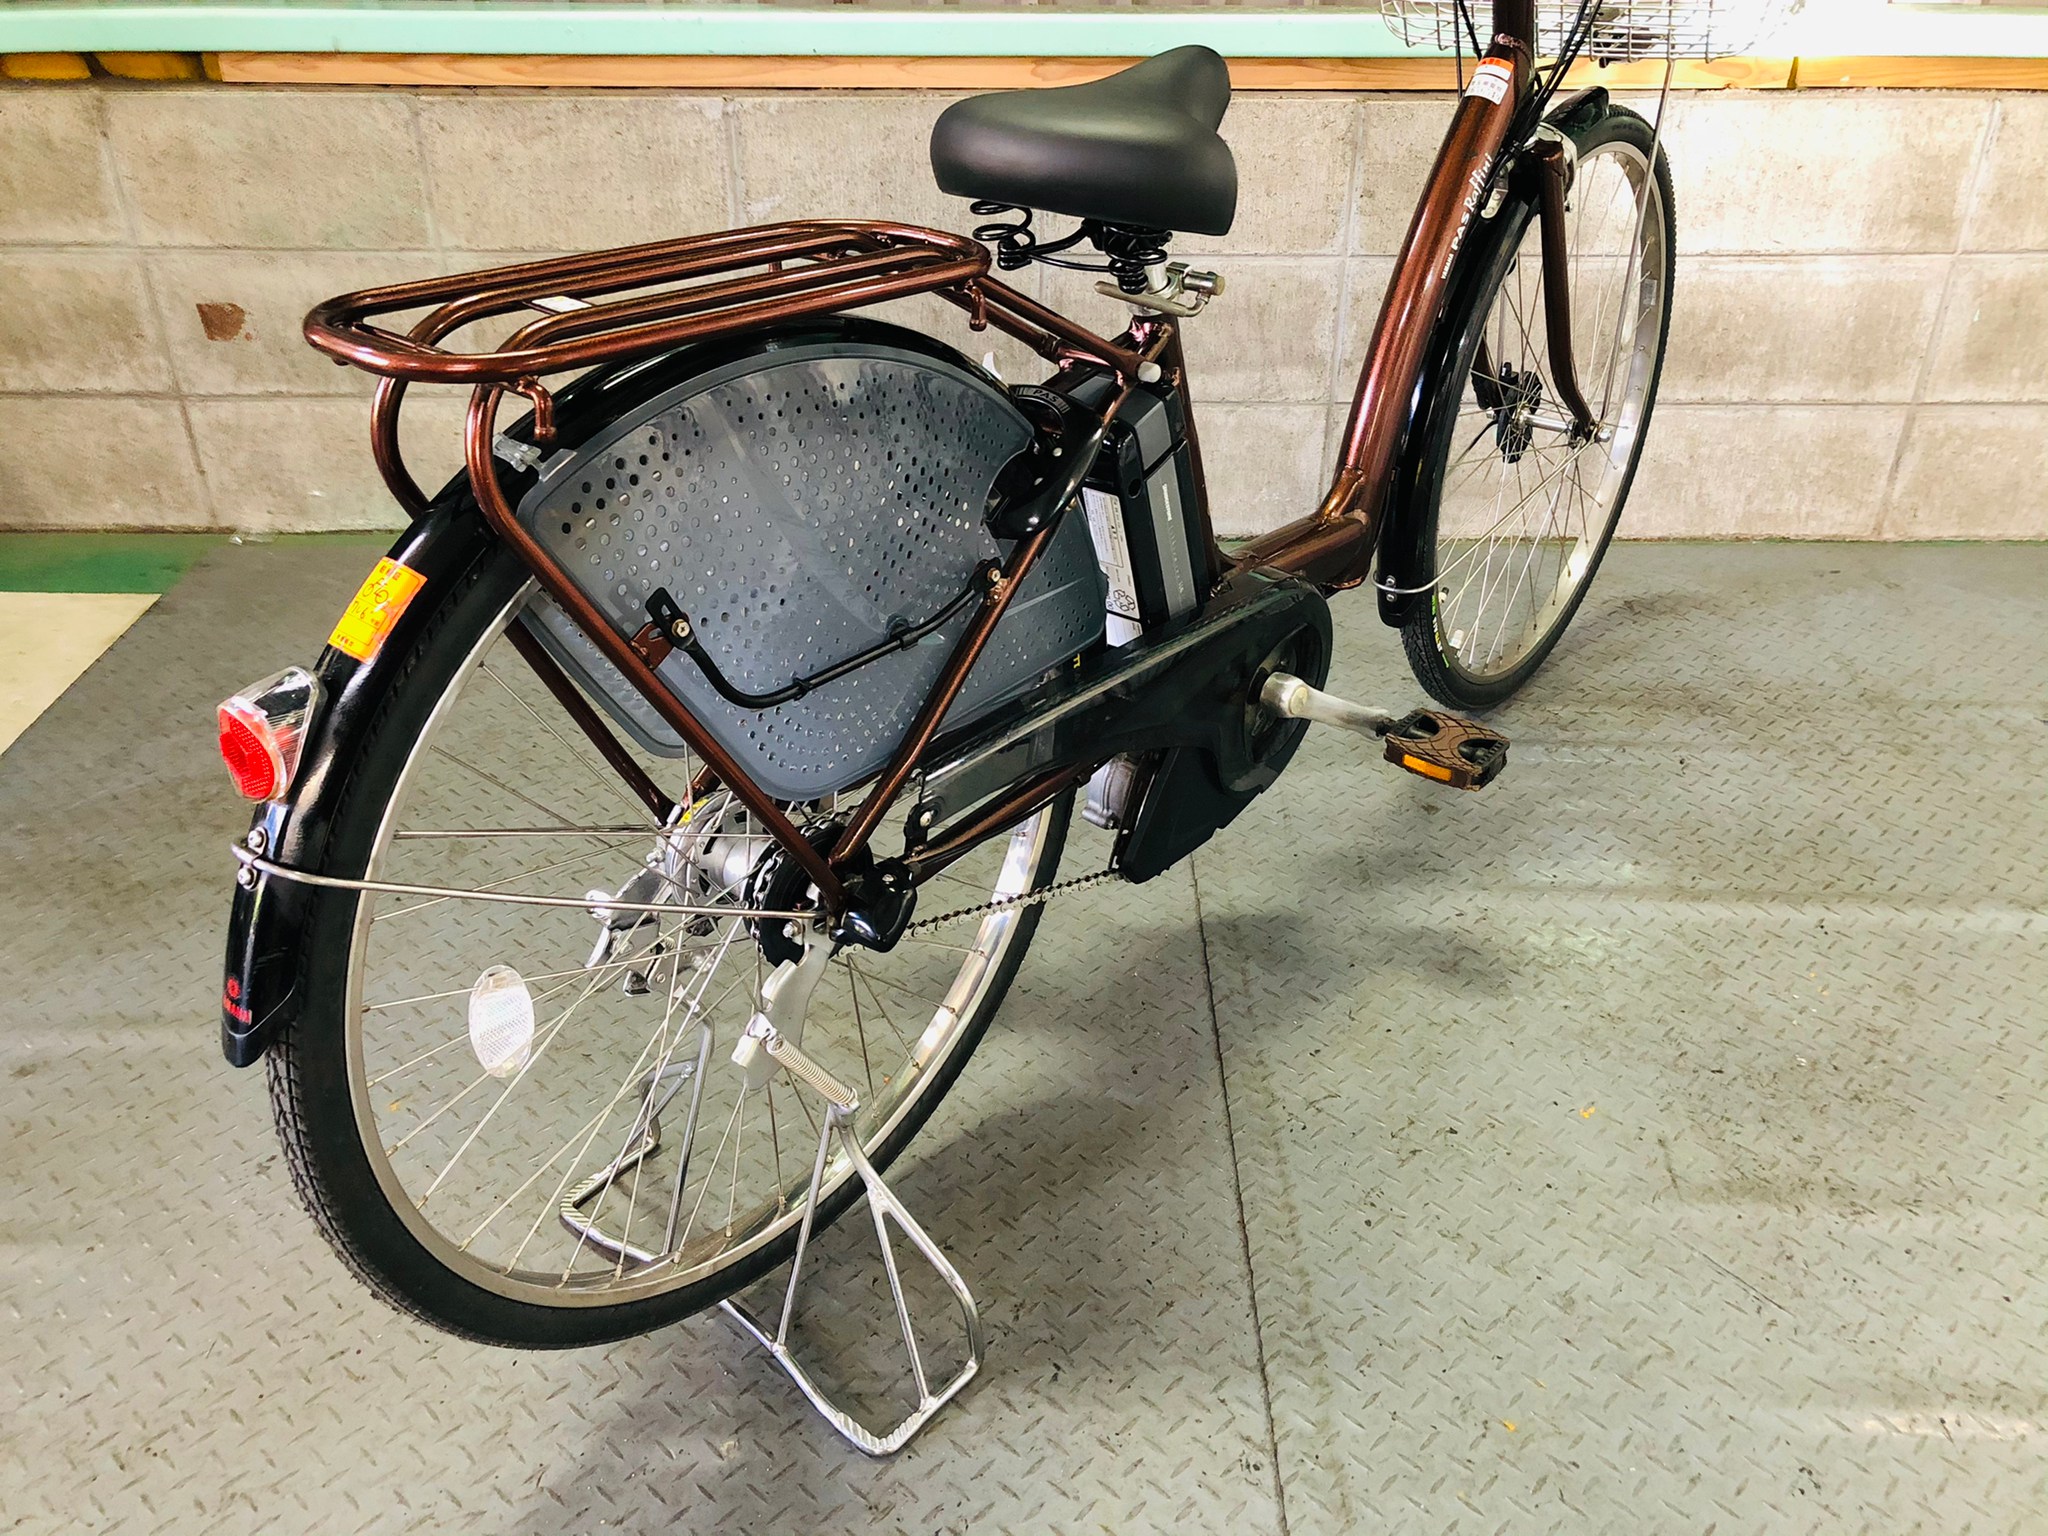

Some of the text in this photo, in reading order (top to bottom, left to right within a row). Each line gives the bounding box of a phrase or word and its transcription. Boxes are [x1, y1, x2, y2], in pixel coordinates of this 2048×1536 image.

[1441, 152, 1492, 279] YAMAHA PAS Raffini
[1033, 389, 1059, 402] PAS
